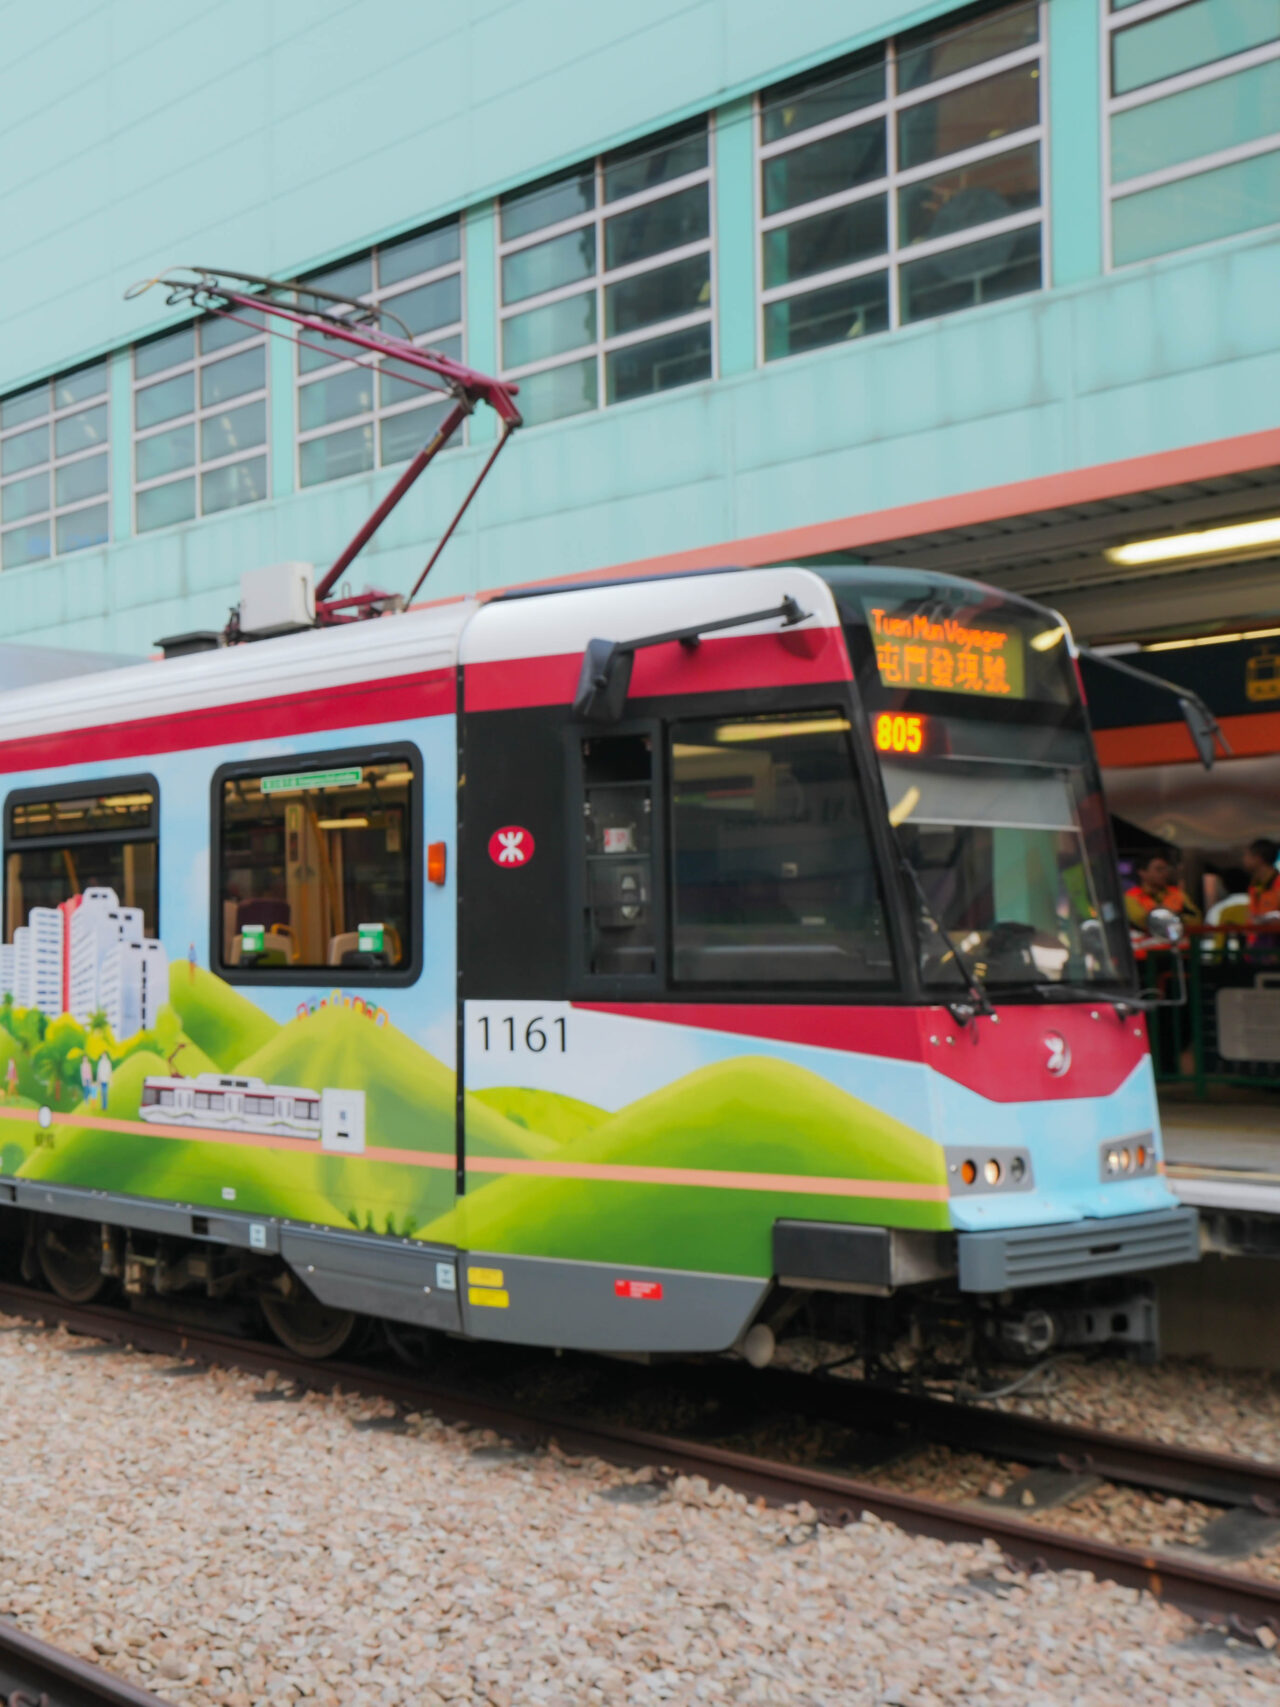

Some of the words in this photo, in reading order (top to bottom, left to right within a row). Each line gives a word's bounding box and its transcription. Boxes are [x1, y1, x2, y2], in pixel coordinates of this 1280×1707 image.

[871, 609, 912, 638] Tuen
[912, 614, 944, 642] Mun
[943, 618, 1008, 654] Voyager
[876, 642, 1011, 694] 屯門發現號
[876, 714, 923, 753] 805
[478, 1016, 566, 1053] 1161
